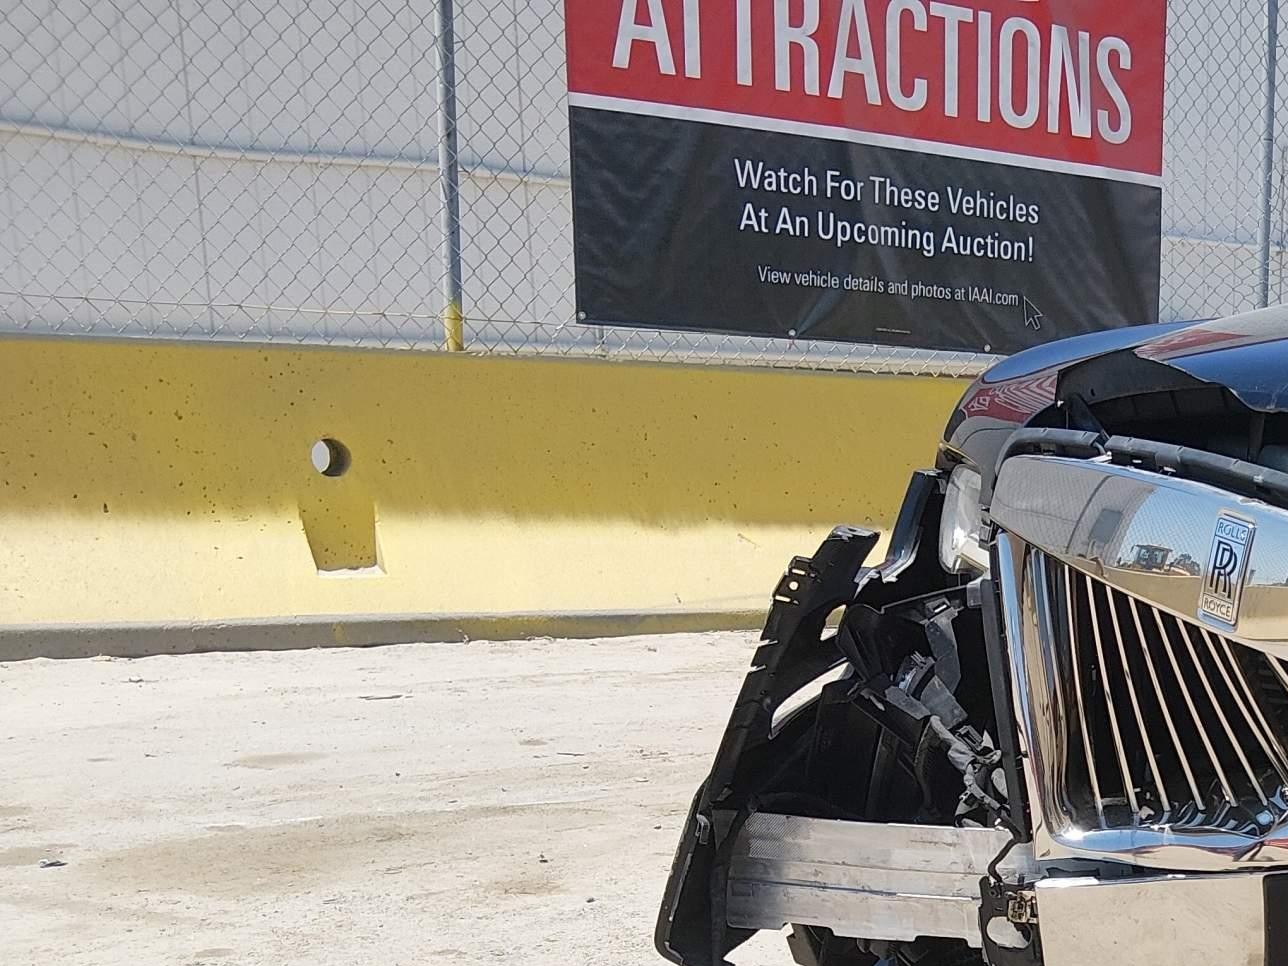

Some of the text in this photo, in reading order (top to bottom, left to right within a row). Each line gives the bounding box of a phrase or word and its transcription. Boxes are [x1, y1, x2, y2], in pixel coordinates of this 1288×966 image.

[734, 158, 1040, 225] Watch For These Vehicles
[739, 202, 1034, 263] At An Upcoming Auction!
[757, 265, 1019, 307] View vehicle details and photos at IAAI.com
[1217, 521, 1247, 541] ROLLS
[1203, 597, 1232, 618] ROYCE
